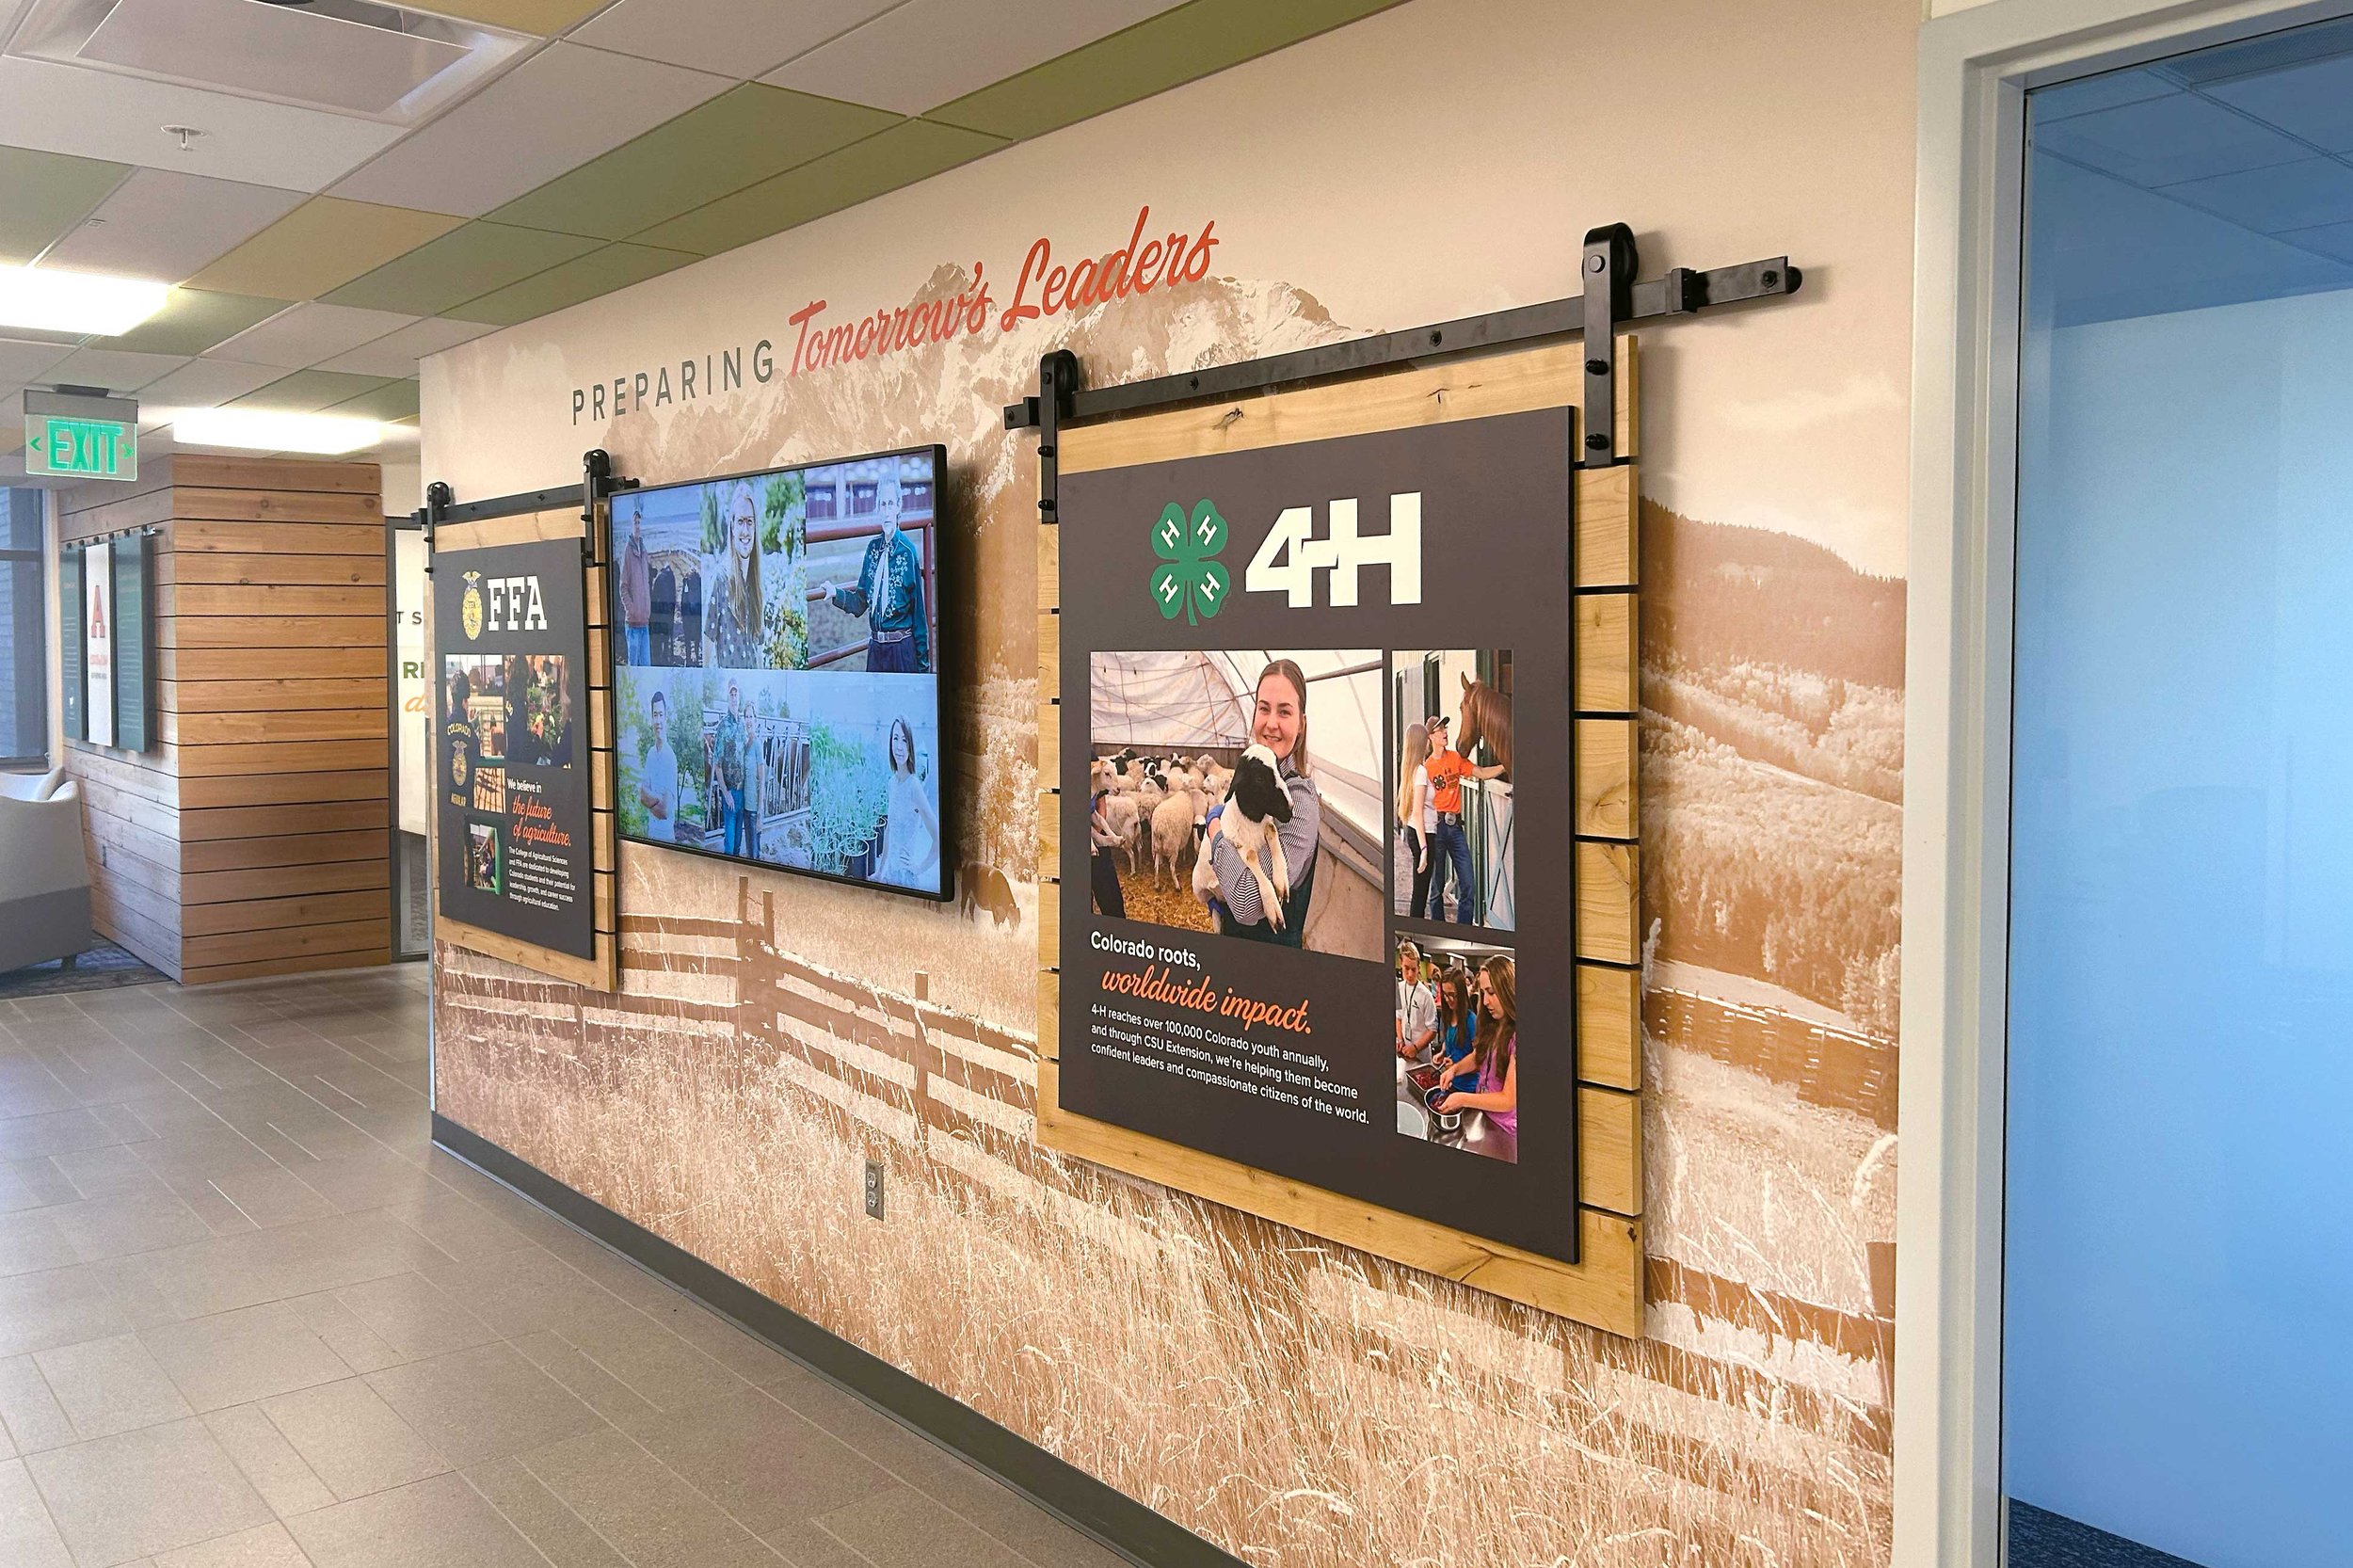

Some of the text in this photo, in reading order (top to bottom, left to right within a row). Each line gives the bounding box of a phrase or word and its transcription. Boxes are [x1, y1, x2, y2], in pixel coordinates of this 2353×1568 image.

[572, 205, 1220, 425] PREPARING Tomorrow's Leaders
[47, 420, 123, 474] EXIT
[488, 576, 548, 631] FFA
[448, 723, 471, 738] COLORADO
[507, 777, 541, 793] We believe in
[513, 794, 552, 821] the future
[513, 817, 571, 846] of agriculture.
[1091, 931, 1201, 971] Colorado roots,
[1101, 965, 1311, 1034] worldwide impact.
[1092, 1003, 1329, 1072] 4-H reaches over 100,000 Colorado youth annually,
[1092, 1024, 1358, 1099] and through CSU Extension, we're helping them become
[1092, 1043, 1369, 1124] confident leaders and compassionate citizens of the world.
